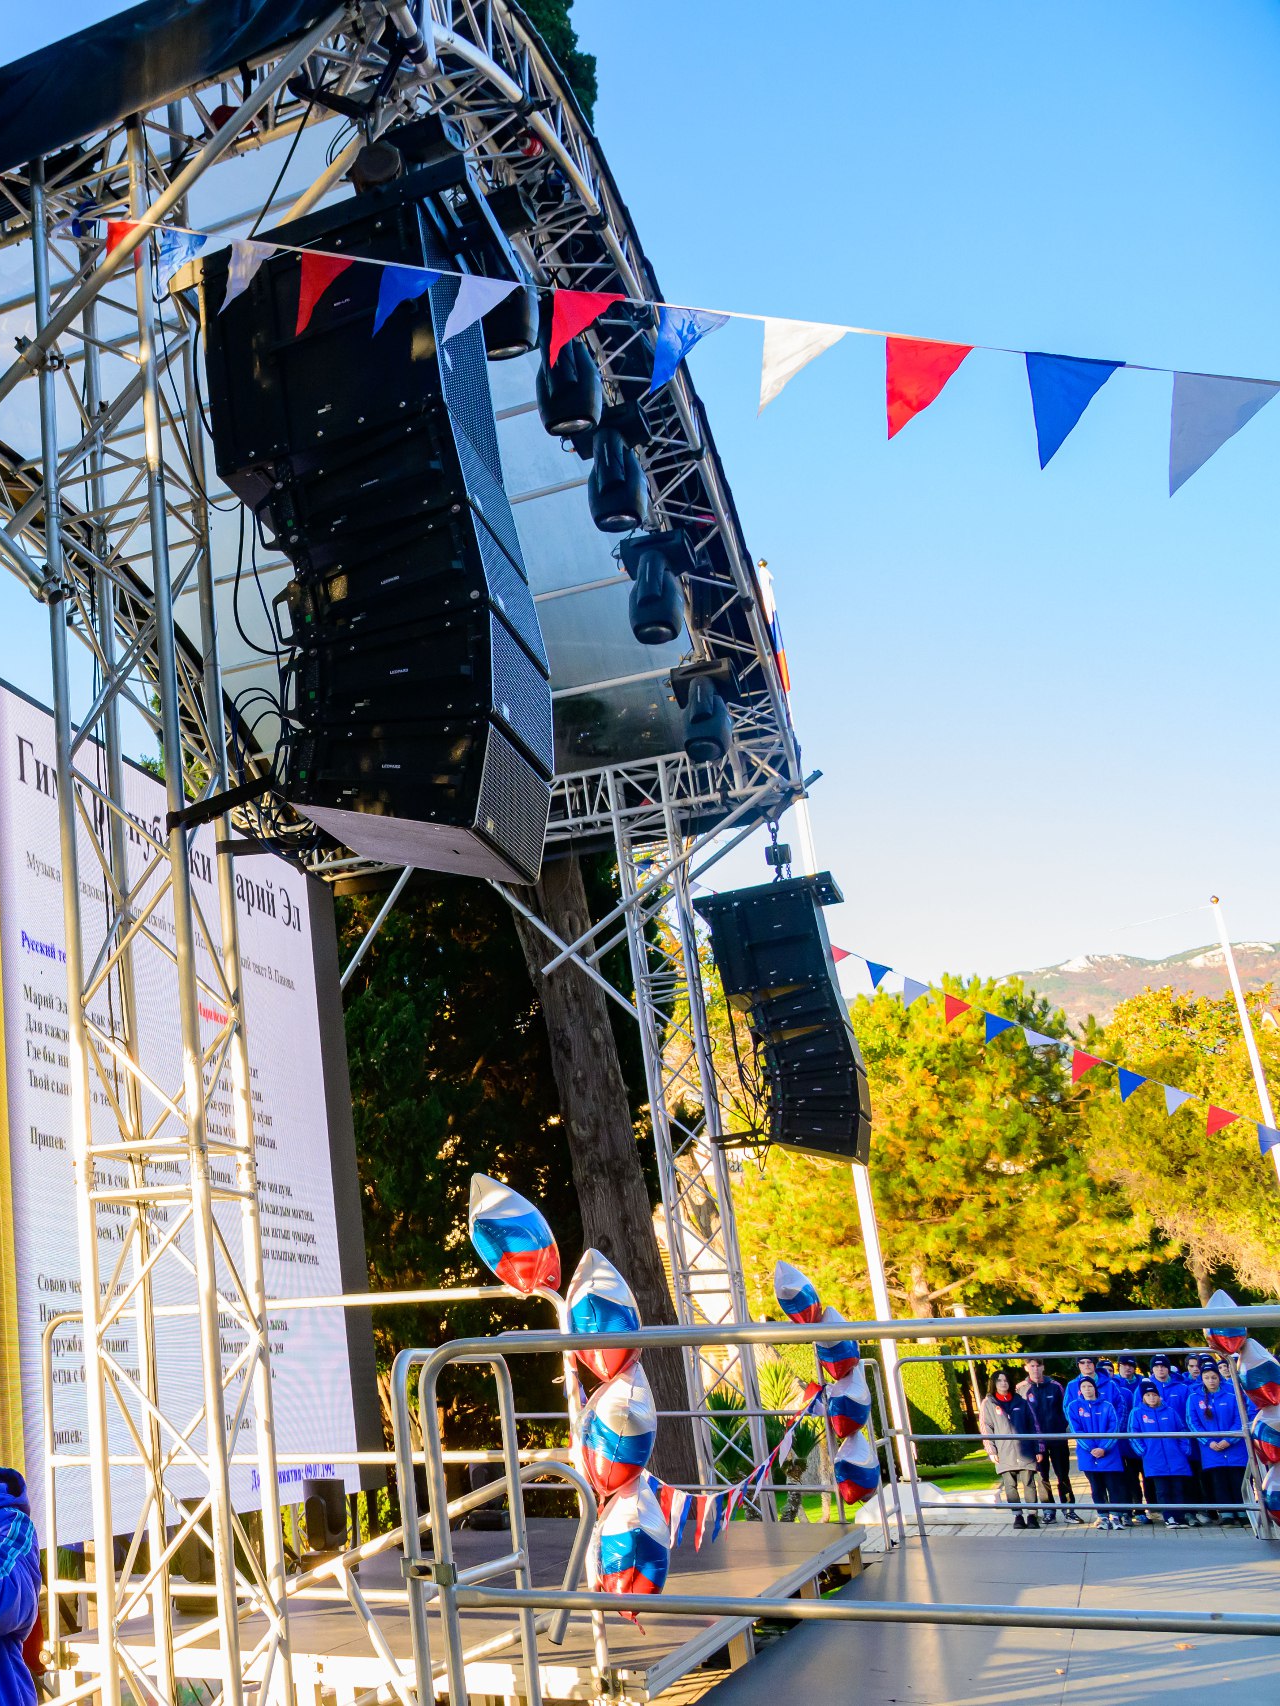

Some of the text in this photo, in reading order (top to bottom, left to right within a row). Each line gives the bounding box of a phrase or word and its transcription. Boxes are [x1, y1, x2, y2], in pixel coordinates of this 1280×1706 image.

[26, 850, 62, 883] Музыка
[235, 872, 278, 920] арий
[279, 885, 303, 933] Эл
[21, 929, 57, 960] Русский
[23, 984, 55, 1011] Марий
[26, 1013, 43, 1034] Для
[27, 1040, 41, 1061] Где
[42, 1045, 55, 1064] бы
[29, 1069, 50, 1092] Твой
[51, 1081, 69, 1097] сын
[30, 1126, 67, 1151] Припев:
[37, 1273, 67, 1294] Совою
[53, 1430, 83, 1445] рипев:
